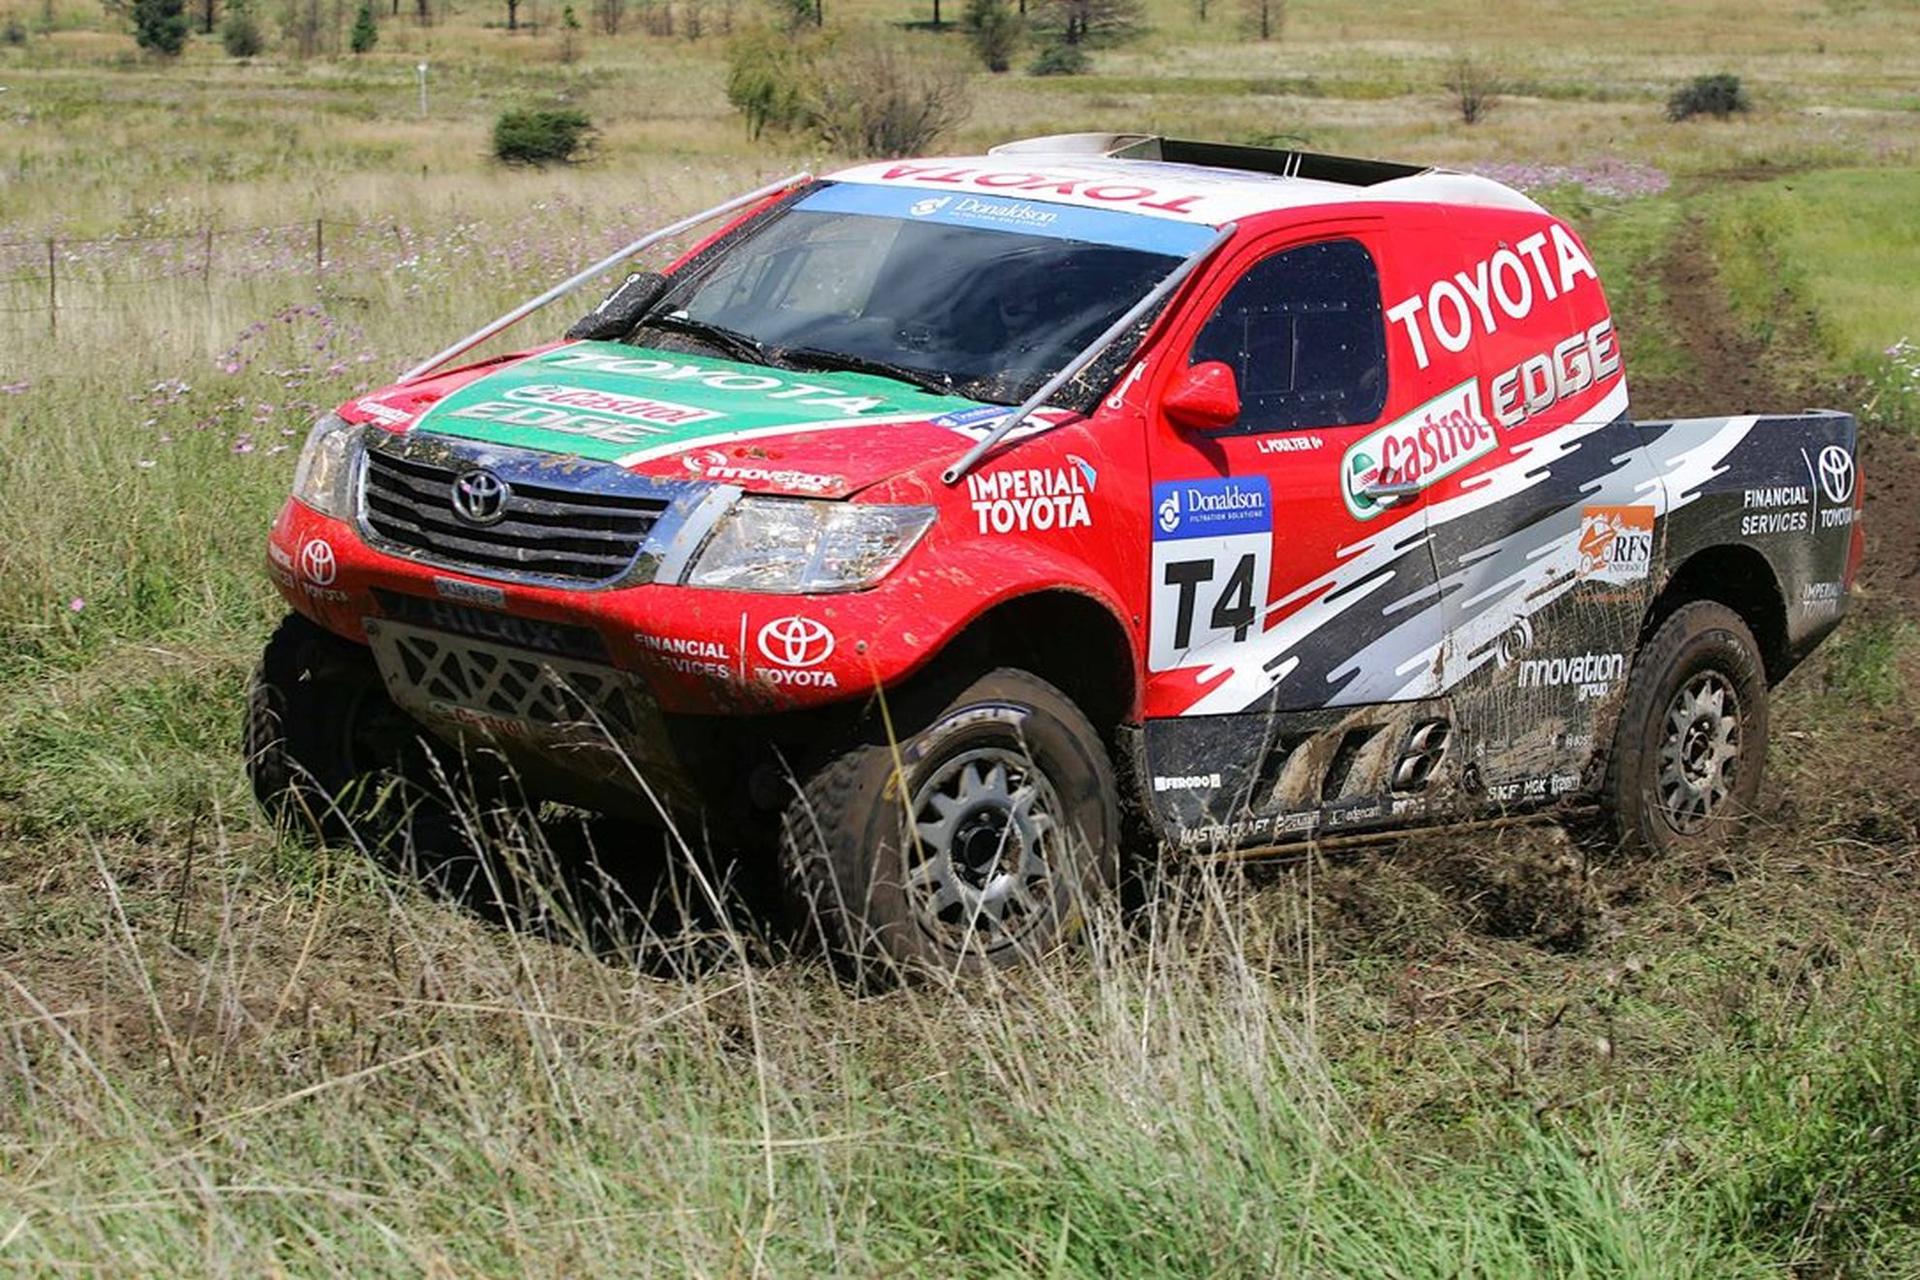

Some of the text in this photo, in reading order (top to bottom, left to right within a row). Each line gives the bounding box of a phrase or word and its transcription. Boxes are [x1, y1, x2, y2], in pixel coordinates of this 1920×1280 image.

[881, 164, 1207, 214] TOYOTA
[954, 198, 1058, 224] Donaldson
[1387, 224, 1597, 370] TOYOTA
[542, 353, 888, 414] TOYOTA
[1491, 317, 1622, 429] EDGE
[450, 402, 676, 445] EDGE
[548, 391, 710, 423] Castrol
[1380, 391, 1489, 483] Castrol
[966, 467, 1085, 501] IMPERIAL
[1187, 485, 1264, 512] Donaldson
[1744, 486, 1809, 508] FINANCIAL
[971, 495, 1092, 534] TOYOTA
[1741, 512, 1807, 535] SERVICES
[1613, 534, 1651, 563] RFS
[1164, 553, 1257, 650] T4
[755, 667, 838, 688] TOYOTA
[1518, 651, 1624, 688] innovation
[1578, 682, 1609, 702] group
[1165, 775, 1211, 789] FERODO
[1487, 784, 1519, 802] SKF
